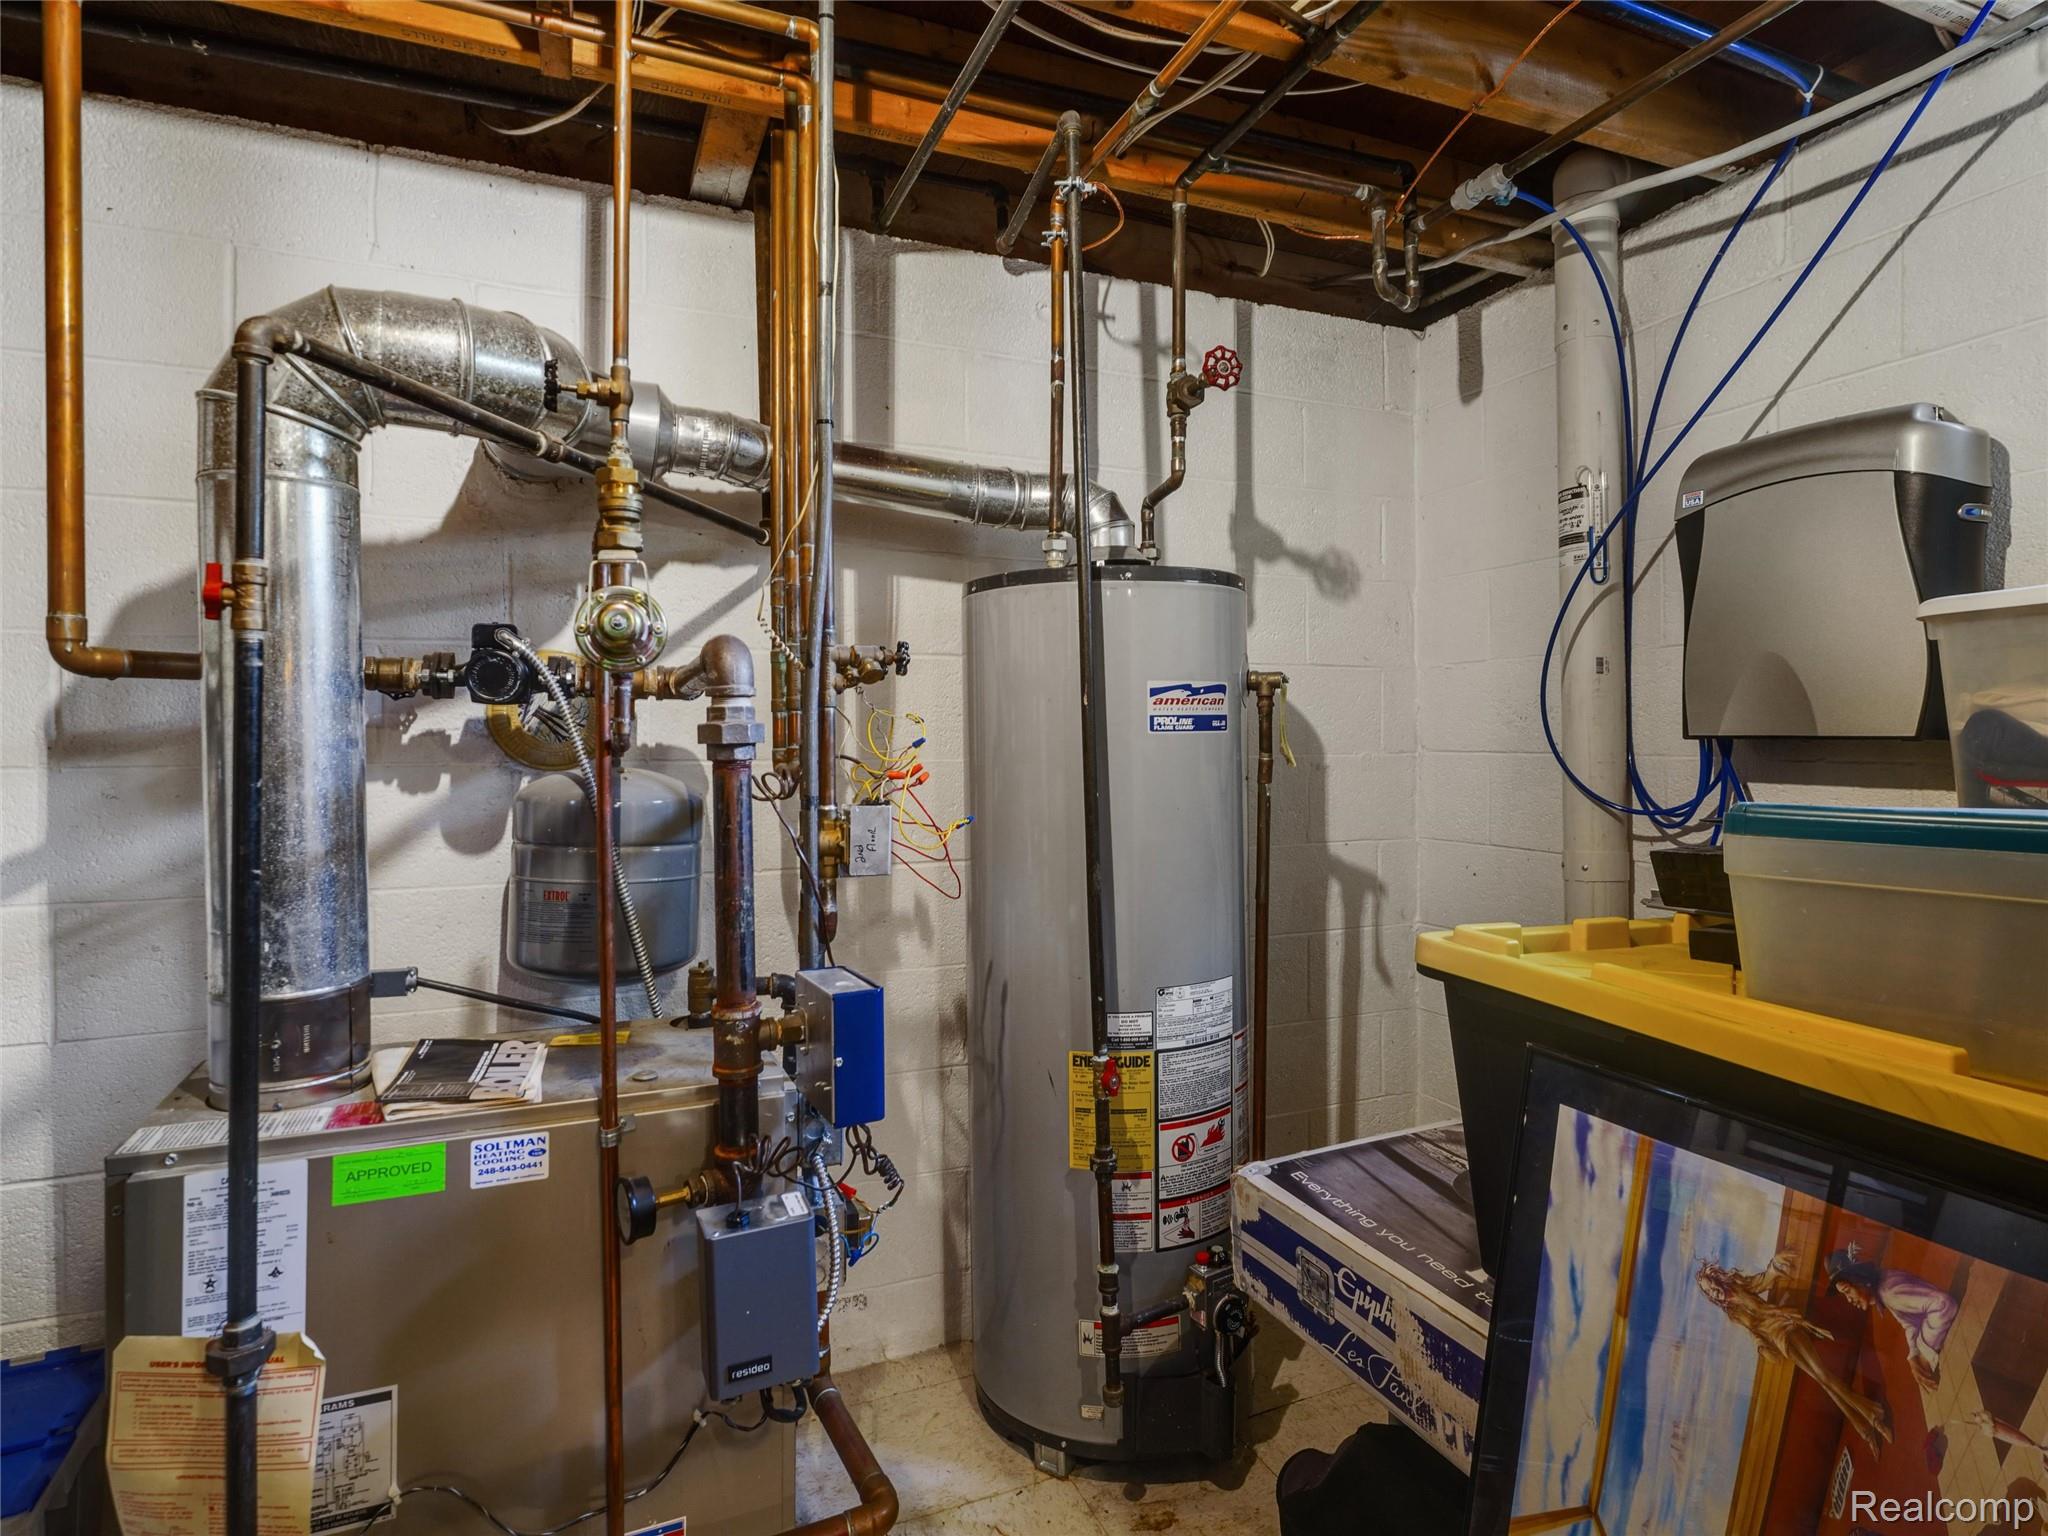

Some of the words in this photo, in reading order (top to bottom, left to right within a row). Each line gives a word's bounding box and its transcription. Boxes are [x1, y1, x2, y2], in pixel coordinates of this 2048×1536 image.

[1685, 495, 1701, 506] USA
[1152, 697, 1224, 706] american
[1153, 716, 1194, 725] PROLINE
[1072, 1055, 1151, 1068] ENEGUIDE
[474, 1135, 546, 1154] SOLTMAN
[473, 1148, 526, 1160] HEATING
[473, 1155, 526, 1167] COOLING
[345, 1161, 433, 1183] APPROVED
[478, 1161, 543, 1176] 248-543-0441
[1290, 1170, 1377, 1229] Everything
[1376, 1227, 1417, 1252] you
[1417, 1252, 1475, 1289] need
[1334, 1266, 1398, 1331] Epiph
[1320, 1330, 1365, 1369] Les
[731, 1361, 771, 1380] resideo
